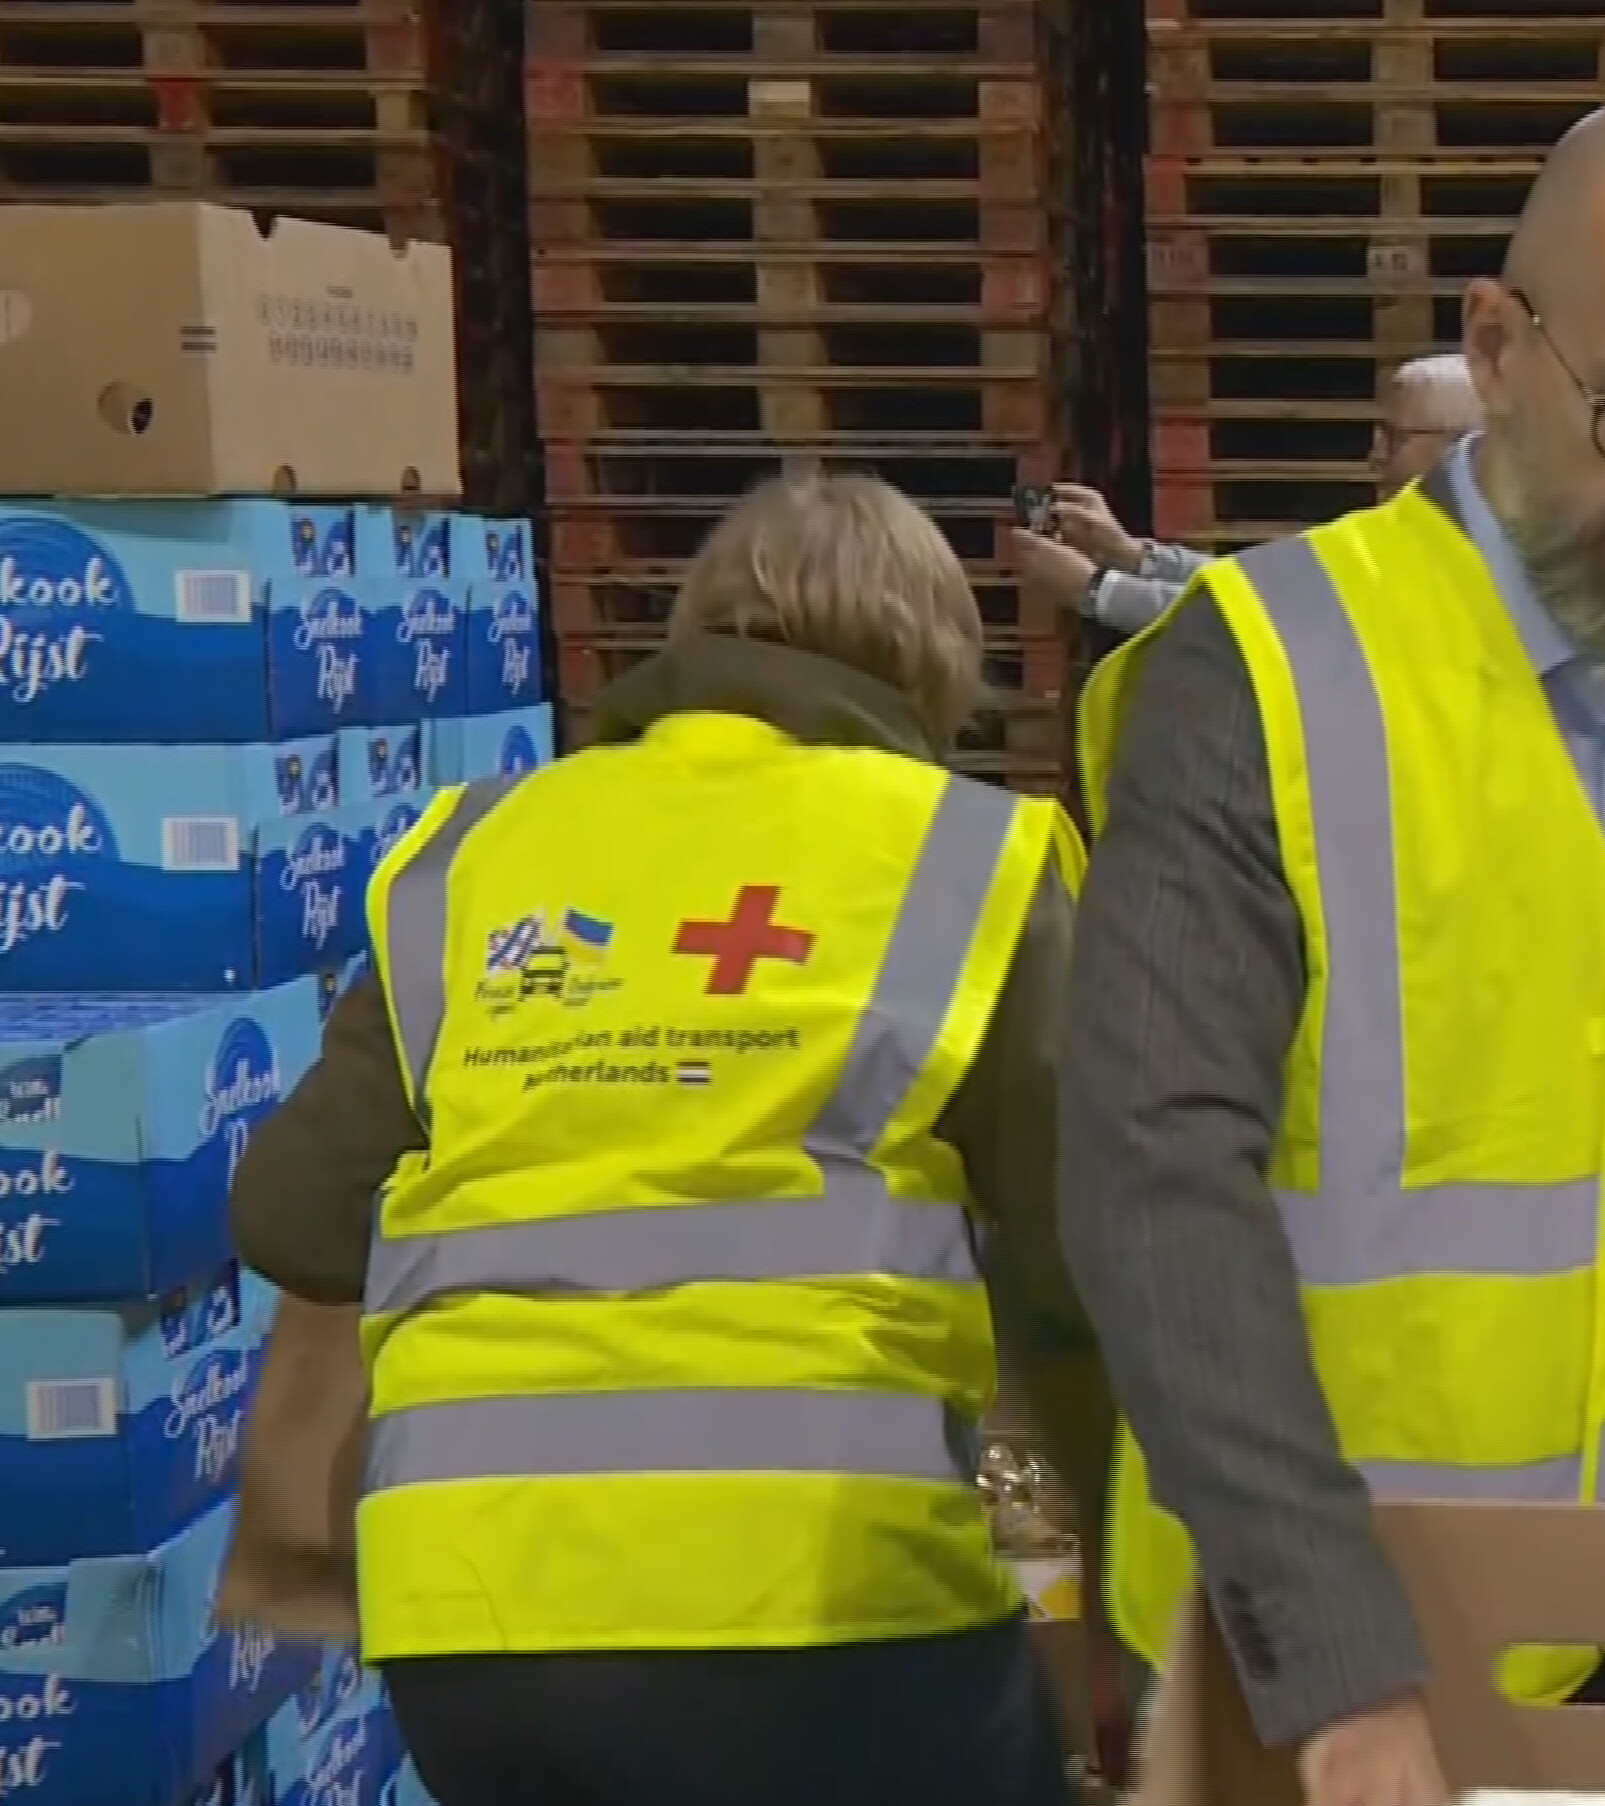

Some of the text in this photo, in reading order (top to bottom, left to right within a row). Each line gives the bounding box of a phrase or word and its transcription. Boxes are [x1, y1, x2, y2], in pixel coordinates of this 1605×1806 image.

[0, 802, 104, 854] ook
[617, 1026, 661, 1047] aid
[666, 1026, 801, 1054] transport
